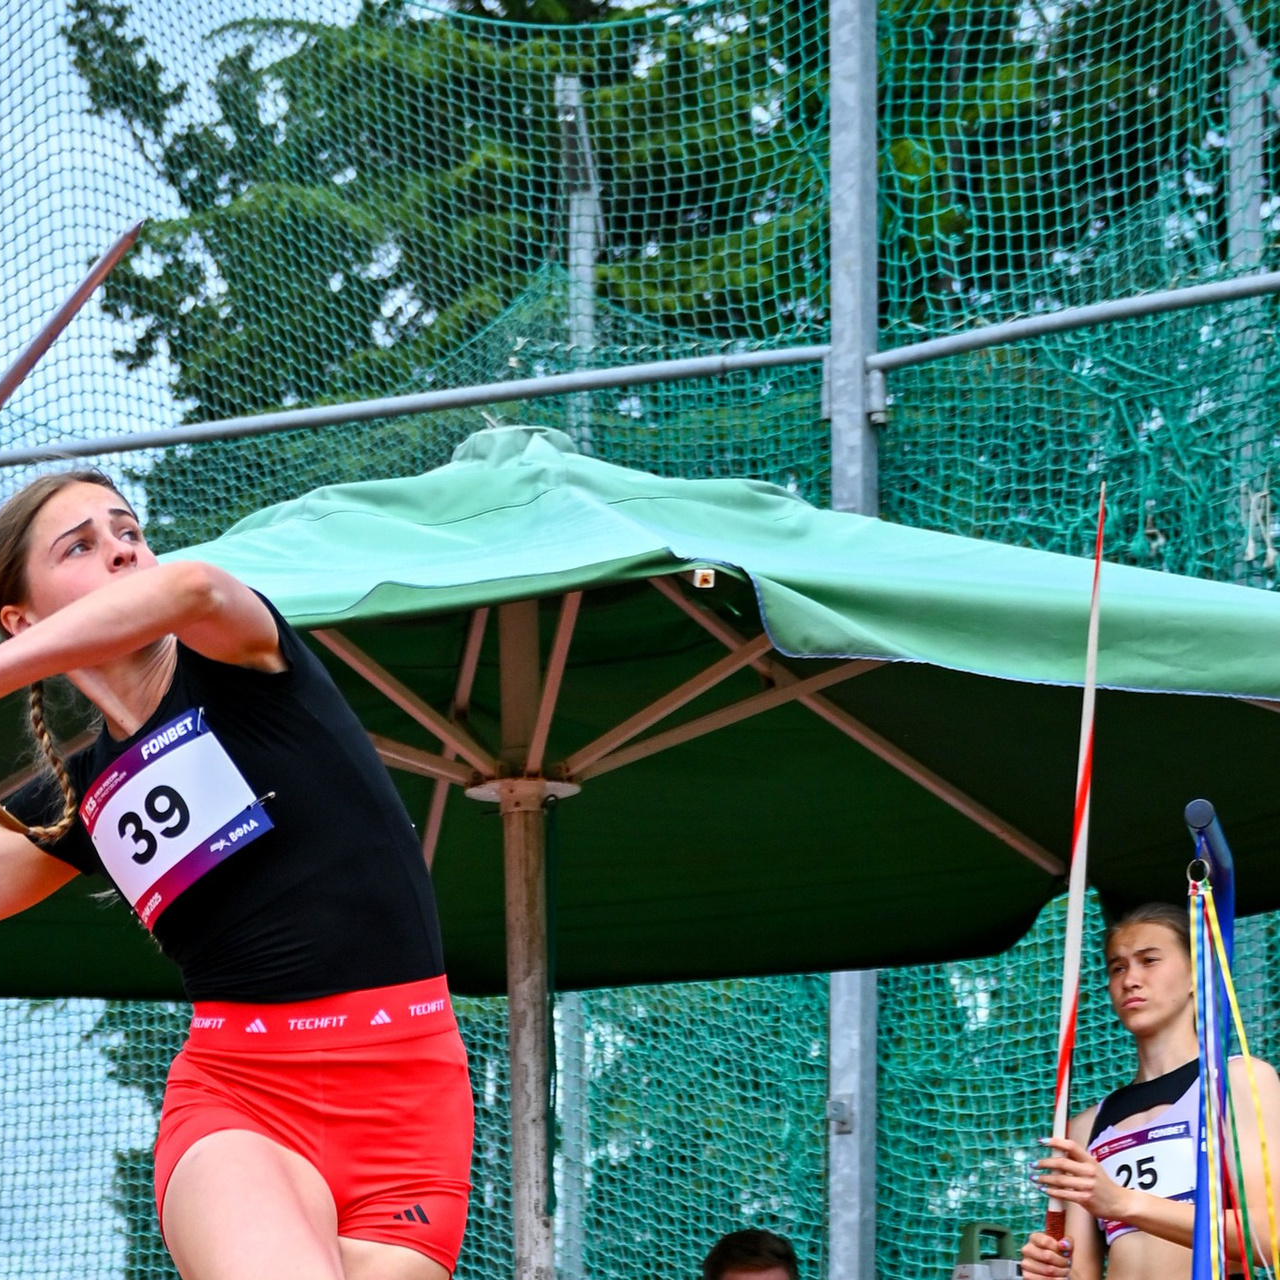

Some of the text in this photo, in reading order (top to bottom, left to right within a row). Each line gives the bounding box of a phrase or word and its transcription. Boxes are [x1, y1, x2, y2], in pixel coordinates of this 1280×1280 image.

[140, 717, 193, 760] FONBET
[118, 785, 190, 865] 39
[228, 819, 259, 842] ВФЛА
[288, 1015, 348, 1031] TECHFIT
[409, 1000, 445, 1017] TECHFIT
[1116, 1156, 1158, 1190] 25
